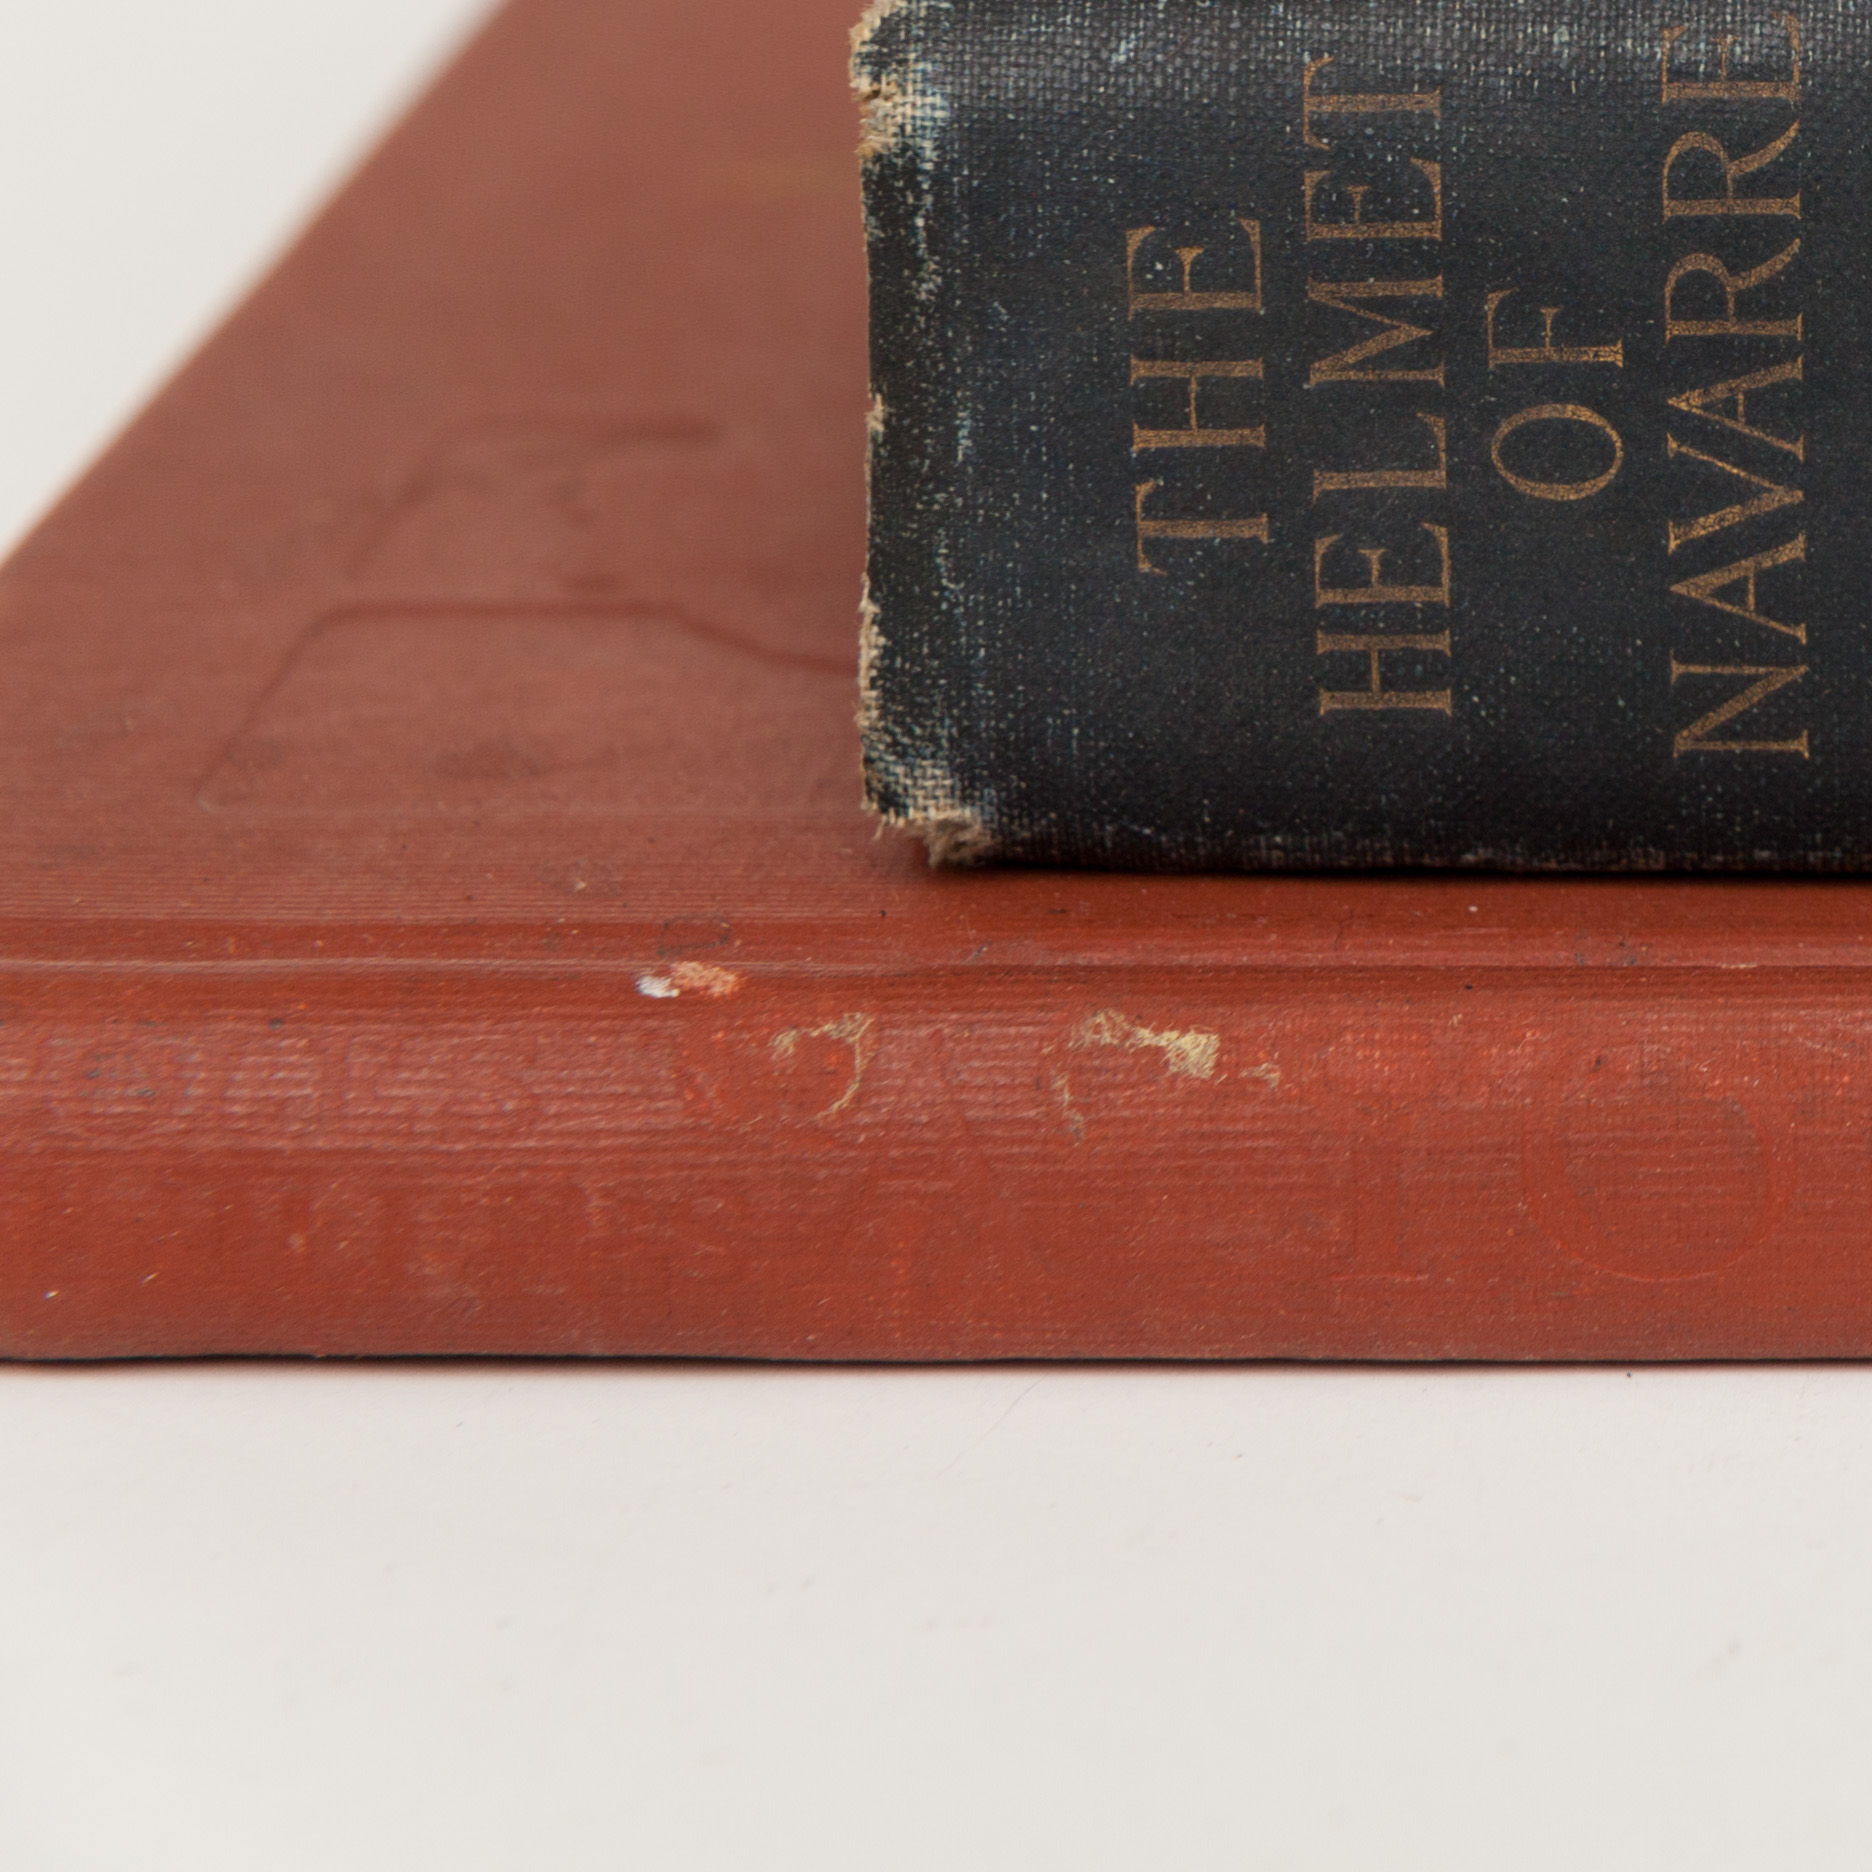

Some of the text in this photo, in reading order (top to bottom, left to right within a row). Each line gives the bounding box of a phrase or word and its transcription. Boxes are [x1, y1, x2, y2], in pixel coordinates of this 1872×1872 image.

[1125, 217, 1270, 576] THE
[1303, 55, 1453, 717] HELMET
[1487, 287, 1625, 503] OF
[1660, 9, 1810, 759] NAVARRE
